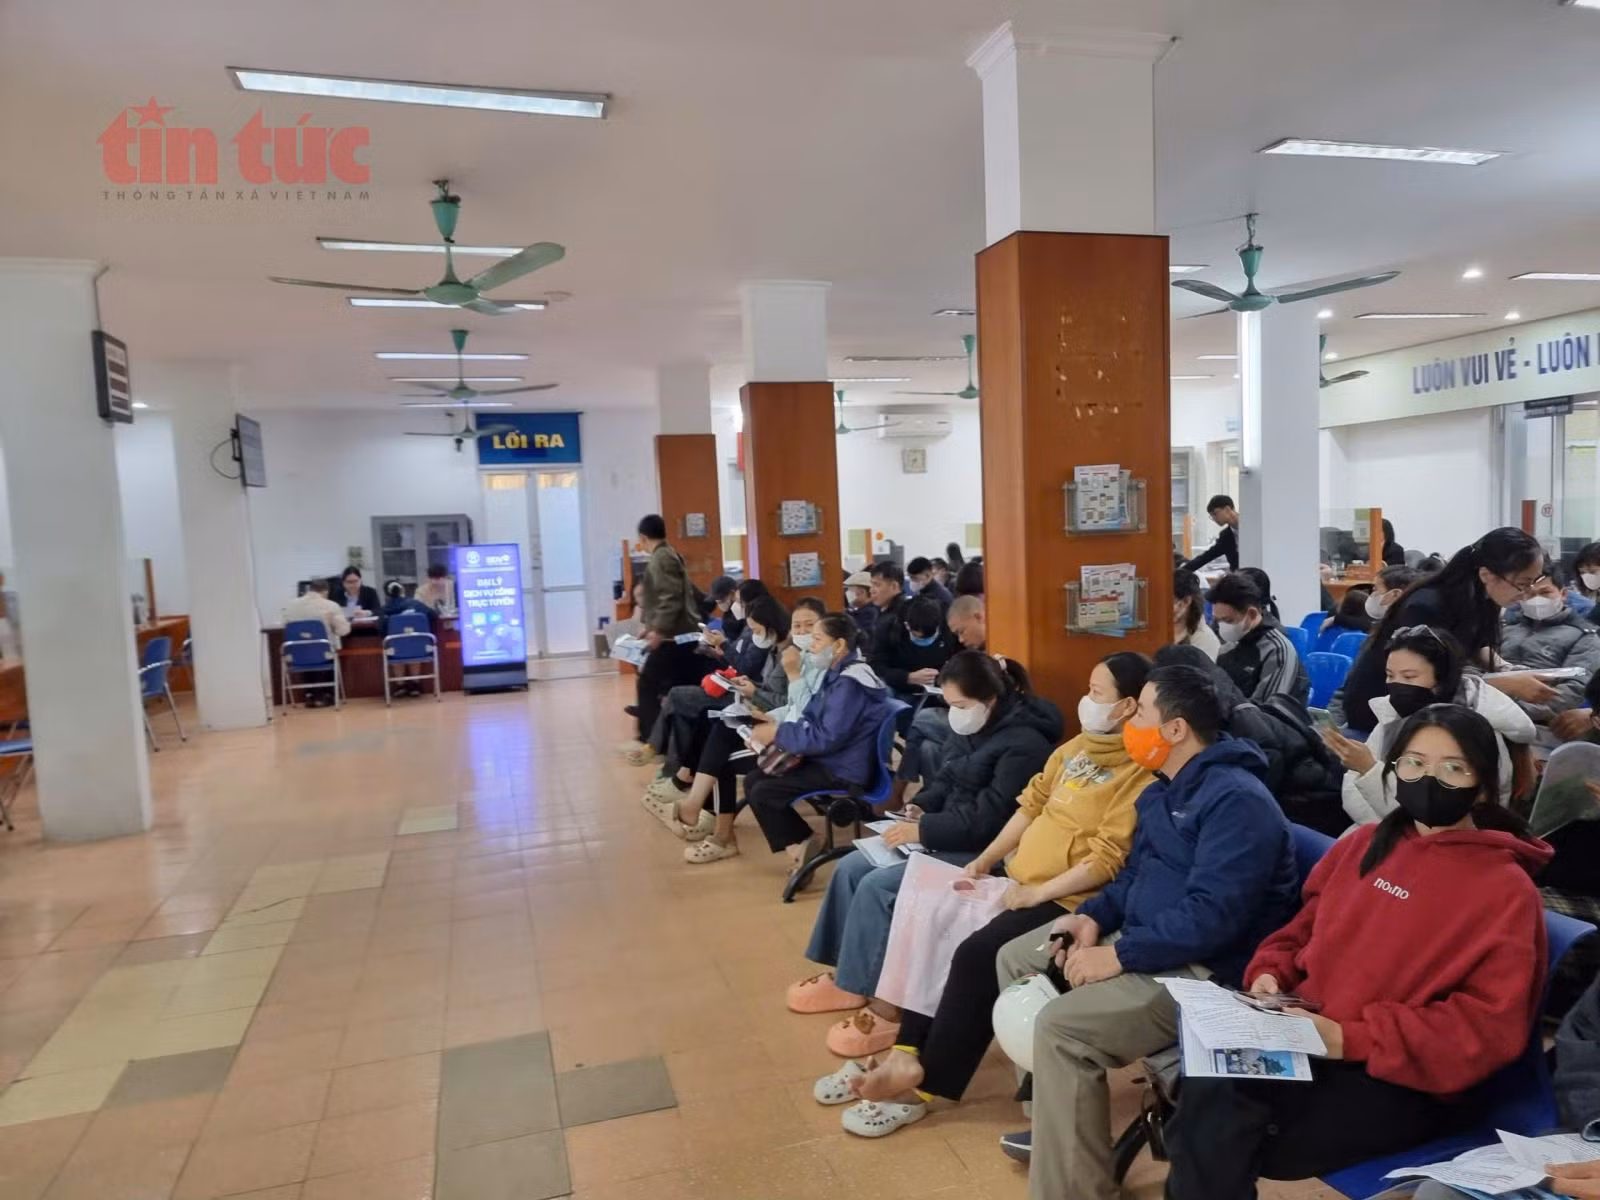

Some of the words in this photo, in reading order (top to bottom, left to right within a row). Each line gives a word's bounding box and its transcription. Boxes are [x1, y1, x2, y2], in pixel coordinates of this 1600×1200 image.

[1460, 353, 1489, 386] VUI
[1536, 332, 1590, 375] LUÔN
[534, 433, 565, 448] RA
